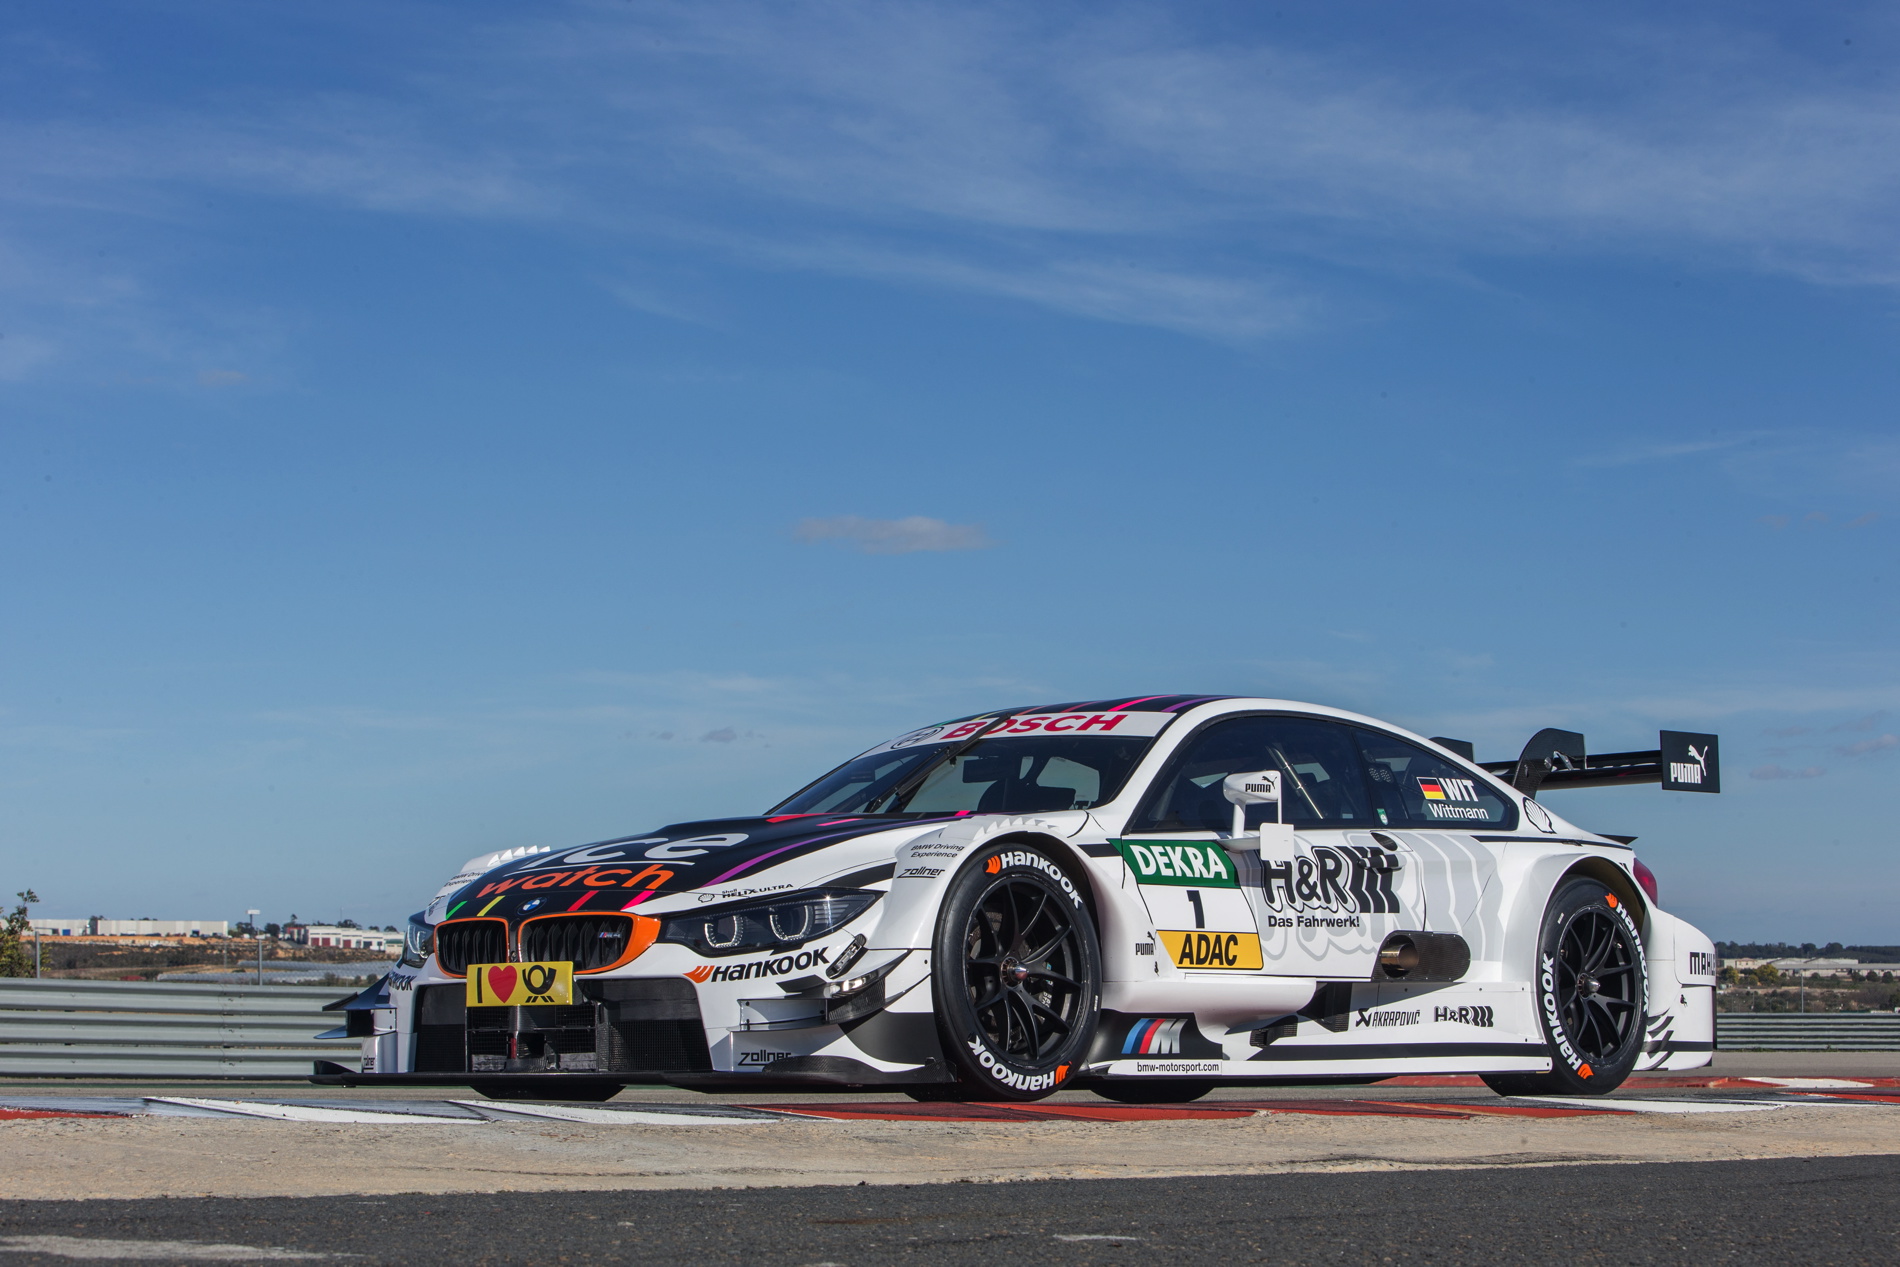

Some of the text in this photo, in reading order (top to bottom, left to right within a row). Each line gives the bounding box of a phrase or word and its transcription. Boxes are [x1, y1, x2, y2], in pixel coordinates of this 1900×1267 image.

[940, 714, 1128, 741] BOSCH
[1670, 762, 1701, 784] PUMA
[1245, 783, 1271, 793] PUMA
[1439, 778, 1479, 801] WIT
[1428, 803, 1489, 819] Wittmann
[933, 843, 965, 851] Driving
[1129, 845, 1228, 879] DEKRA
[476, 864, 675, 898] watch
[897, 866, 945, 879] zollner
[1262, 847, 1354, 910] H&R
[722, 883, 794, 899] HELIX ULTRA
[1186, 889, 1205, 929] 1
[1268, 915, 1360, 928] Das Fahrwerk!
[1135, 942, 1155, 956] PUMA
[1178, 933, 1239, 966] ADAC
[1136, 1061, 1220, 1074] bmw-motorsport.com
